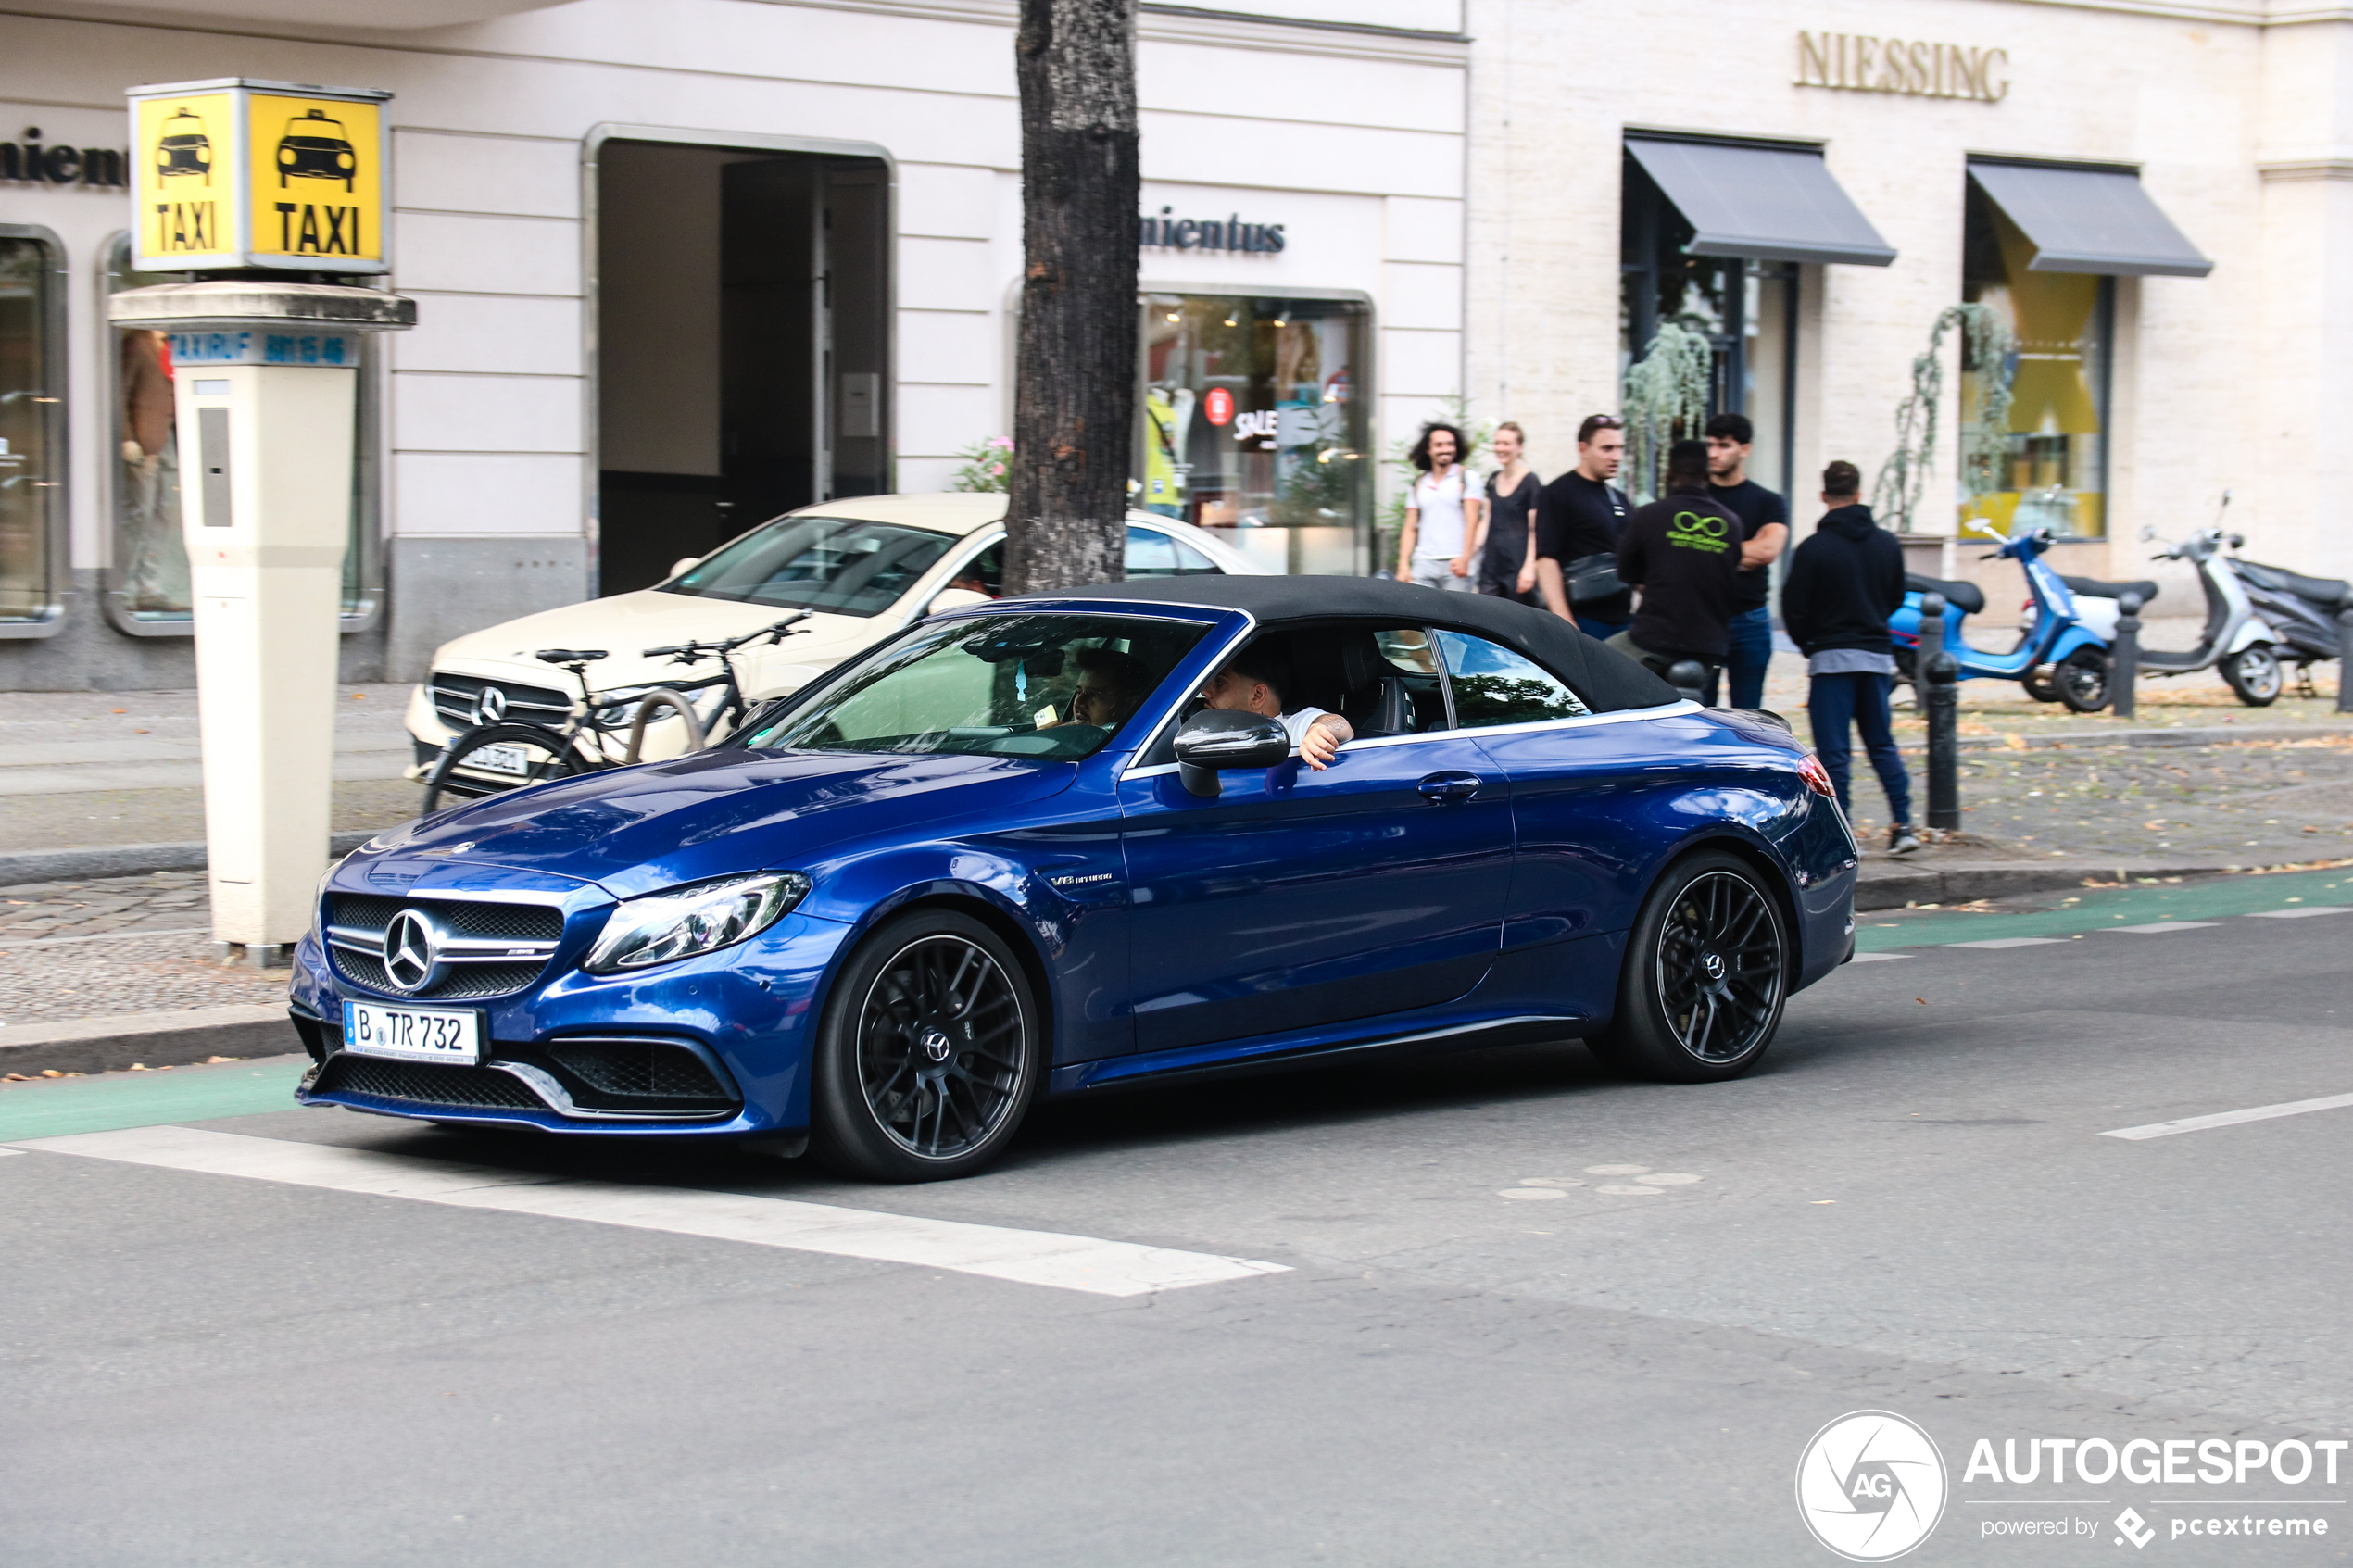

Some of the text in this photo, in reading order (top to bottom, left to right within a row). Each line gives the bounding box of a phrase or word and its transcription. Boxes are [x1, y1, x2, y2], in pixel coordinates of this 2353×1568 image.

[1792, 29, 2011, 105] NIESSING
[157, 200, 216, 252] TAXI
[275, 201, 359, 256] TAXI
[359, 1009, 463, 1051] B TR 732
